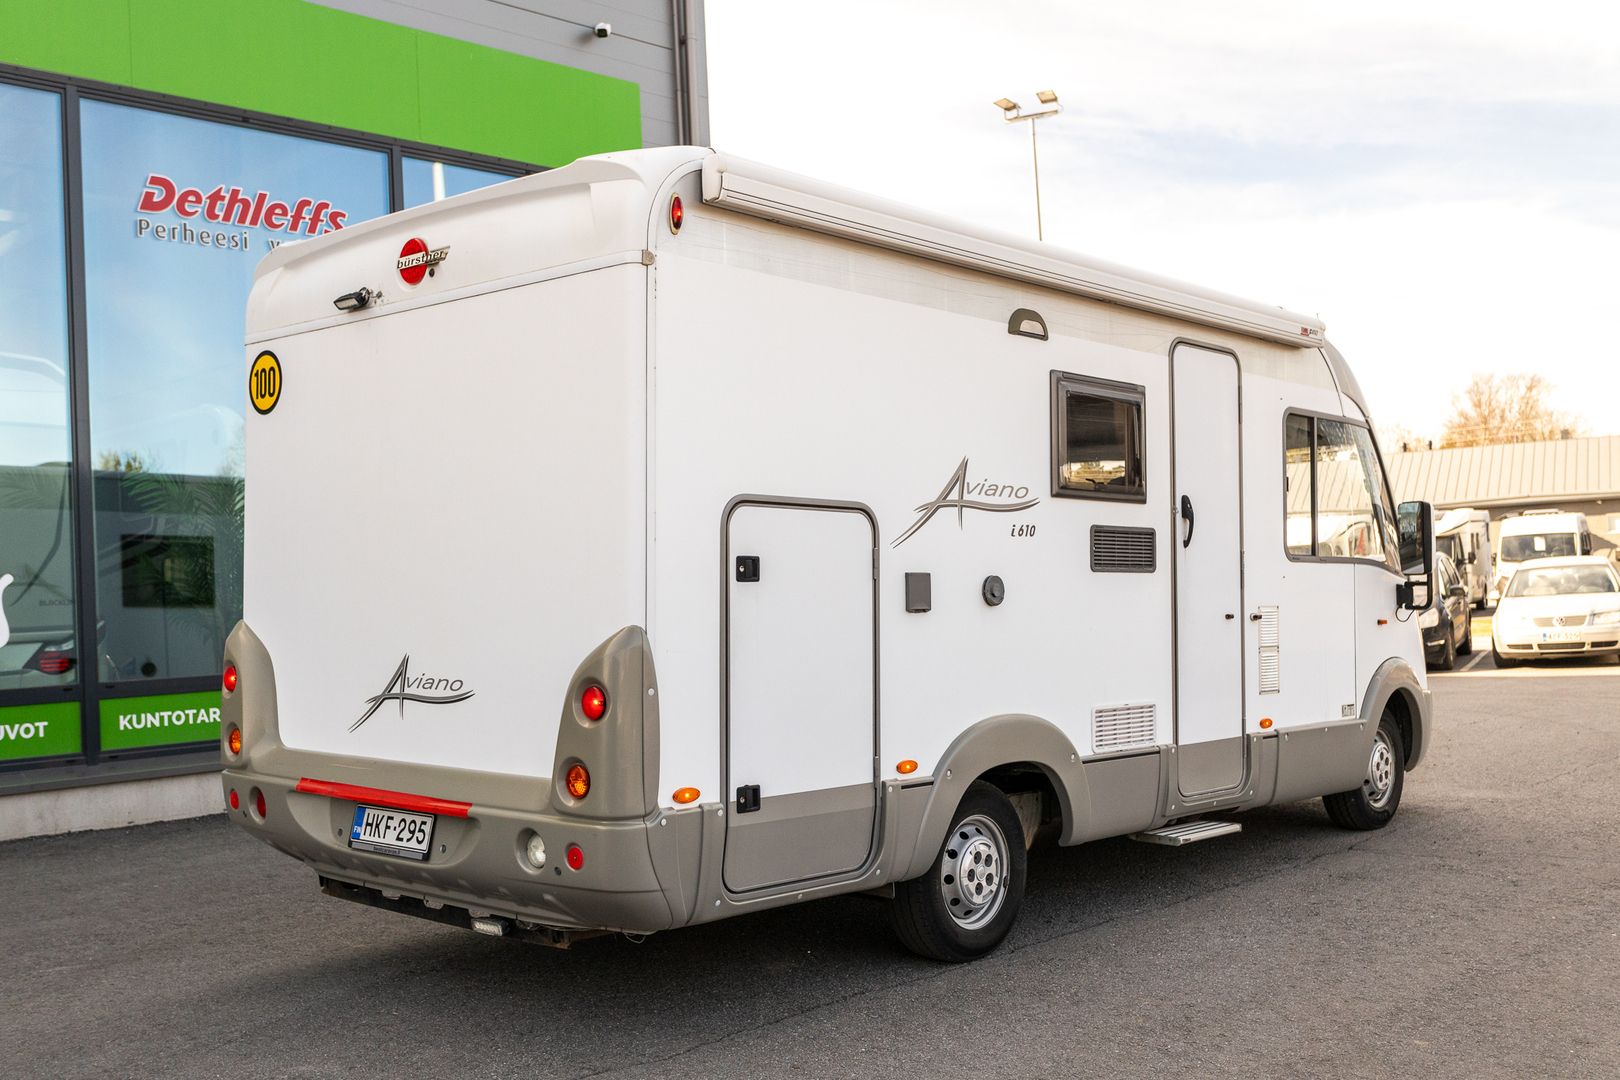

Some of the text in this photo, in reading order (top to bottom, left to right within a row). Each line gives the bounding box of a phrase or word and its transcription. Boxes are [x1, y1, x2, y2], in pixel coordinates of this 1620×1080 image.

[138, 174, 347, 235] Dethleffs
[137, 218, 249, 250] Perheesi
[397, 250, 445, 269] bürstner
[254, 366, 276, 399] 100
[890, 455, 1041, 549] Aviano
[347, 652, 475, 733] Aviano
[363, 812, 428, 845] HKF-295
